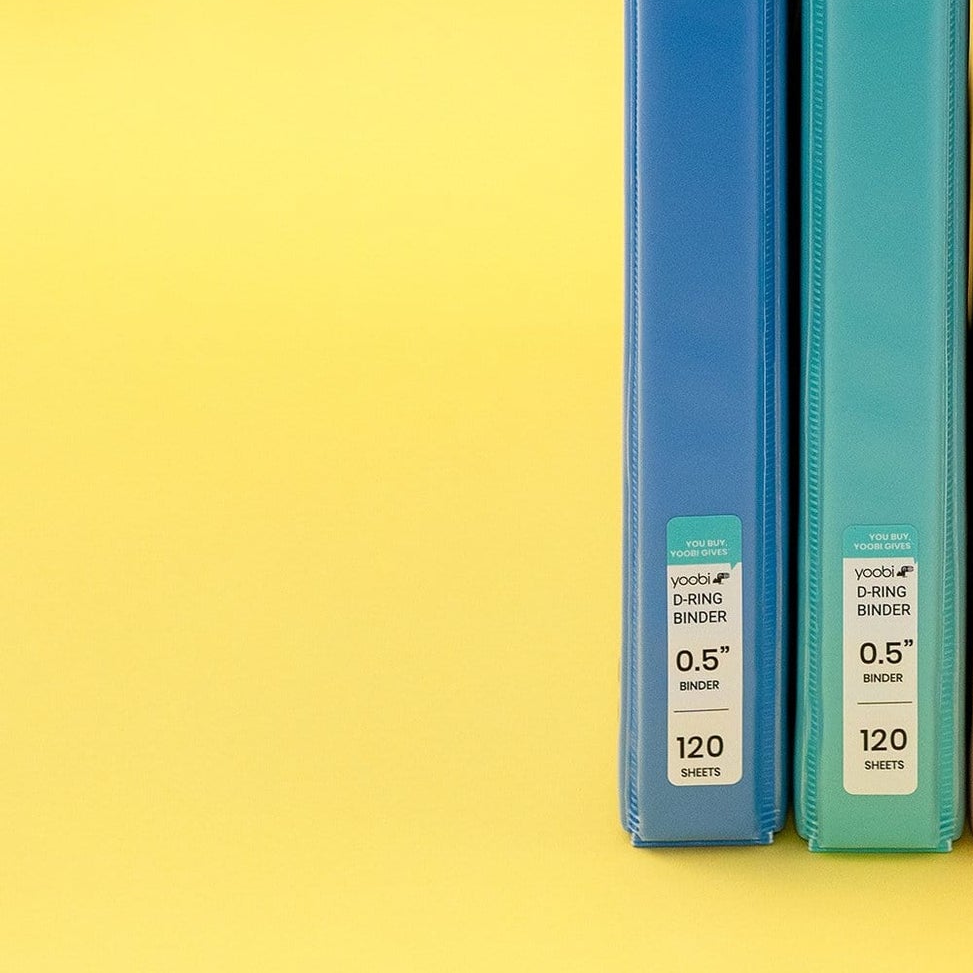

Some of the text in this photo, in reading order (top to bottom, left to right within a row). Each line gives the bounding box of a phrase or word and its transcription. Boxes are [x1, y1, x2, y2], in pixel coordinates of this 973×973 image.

[869, 533, 889, 541] YOU
[685, 540, 705, 548] YOU
[884, 542, 911, 550] GIVES
[670, 548, 728, 558] YOOBI GIVES
[854, 565, 895, 581] yoobi
[670, 572, 711, 589] yoobi
[857, 586, 907, 598] D-RING
[673, 592, 723, 606] D-RING
[857, 603, 911, 616] BINDER
[673, 610, 727, 625] BINDER
[863, 673, 903, 683] BINDER
[679, 680, 720, 691] BINDER
[860, 728, 907, 751] 120
[676, 735, 724, 759] 120
[864, 760, 905, 770] SHEETS
[680, 767, 721, 777] SHEETS
